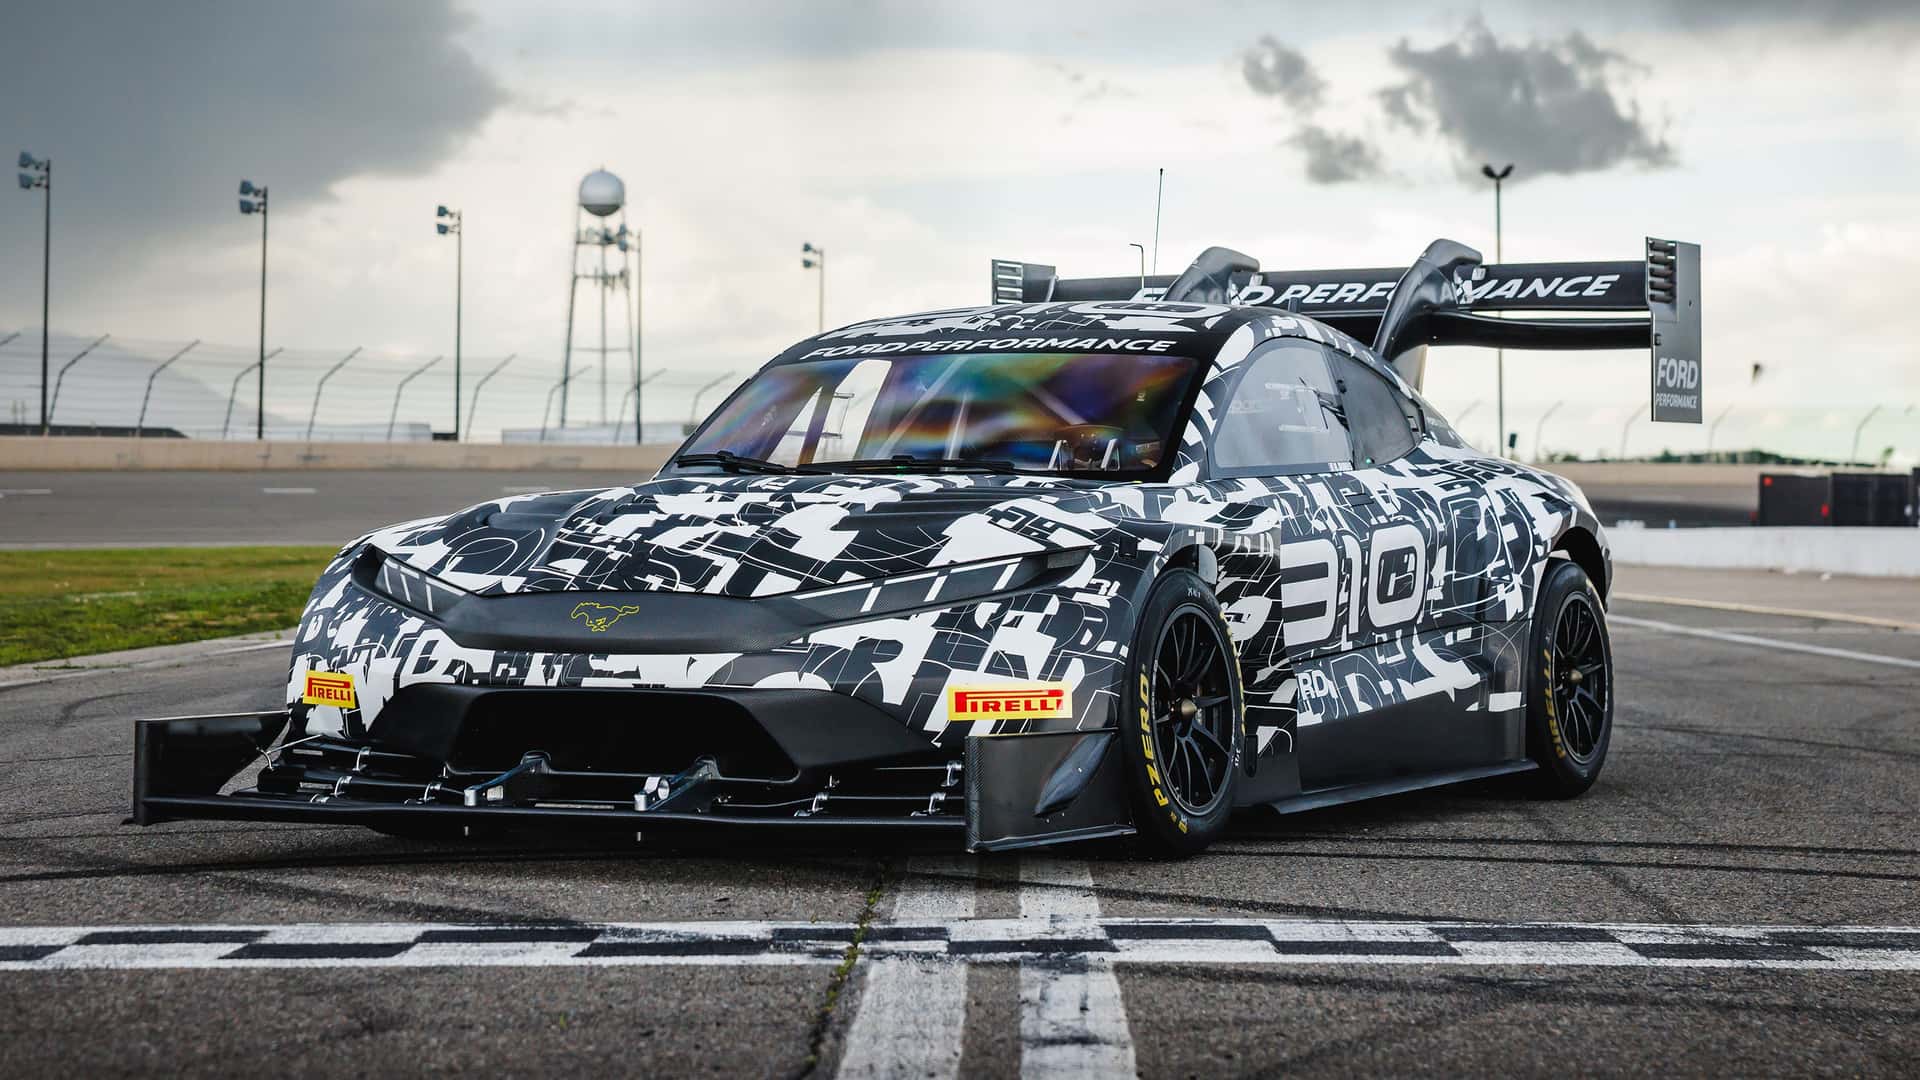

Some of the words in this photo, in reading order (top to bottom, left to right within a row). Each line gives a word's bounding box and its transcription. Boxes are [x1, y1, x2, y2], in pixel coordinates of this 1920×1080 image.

[1656, 357, 1699, 390] FORD
[1655, 392, 1698, 409] PERFORMANCE
[1279, 523, 1427, 648] 310
[306, 676, 352, 702] PIRELLI
[954, 689, 1065, 713] PIRELLI
